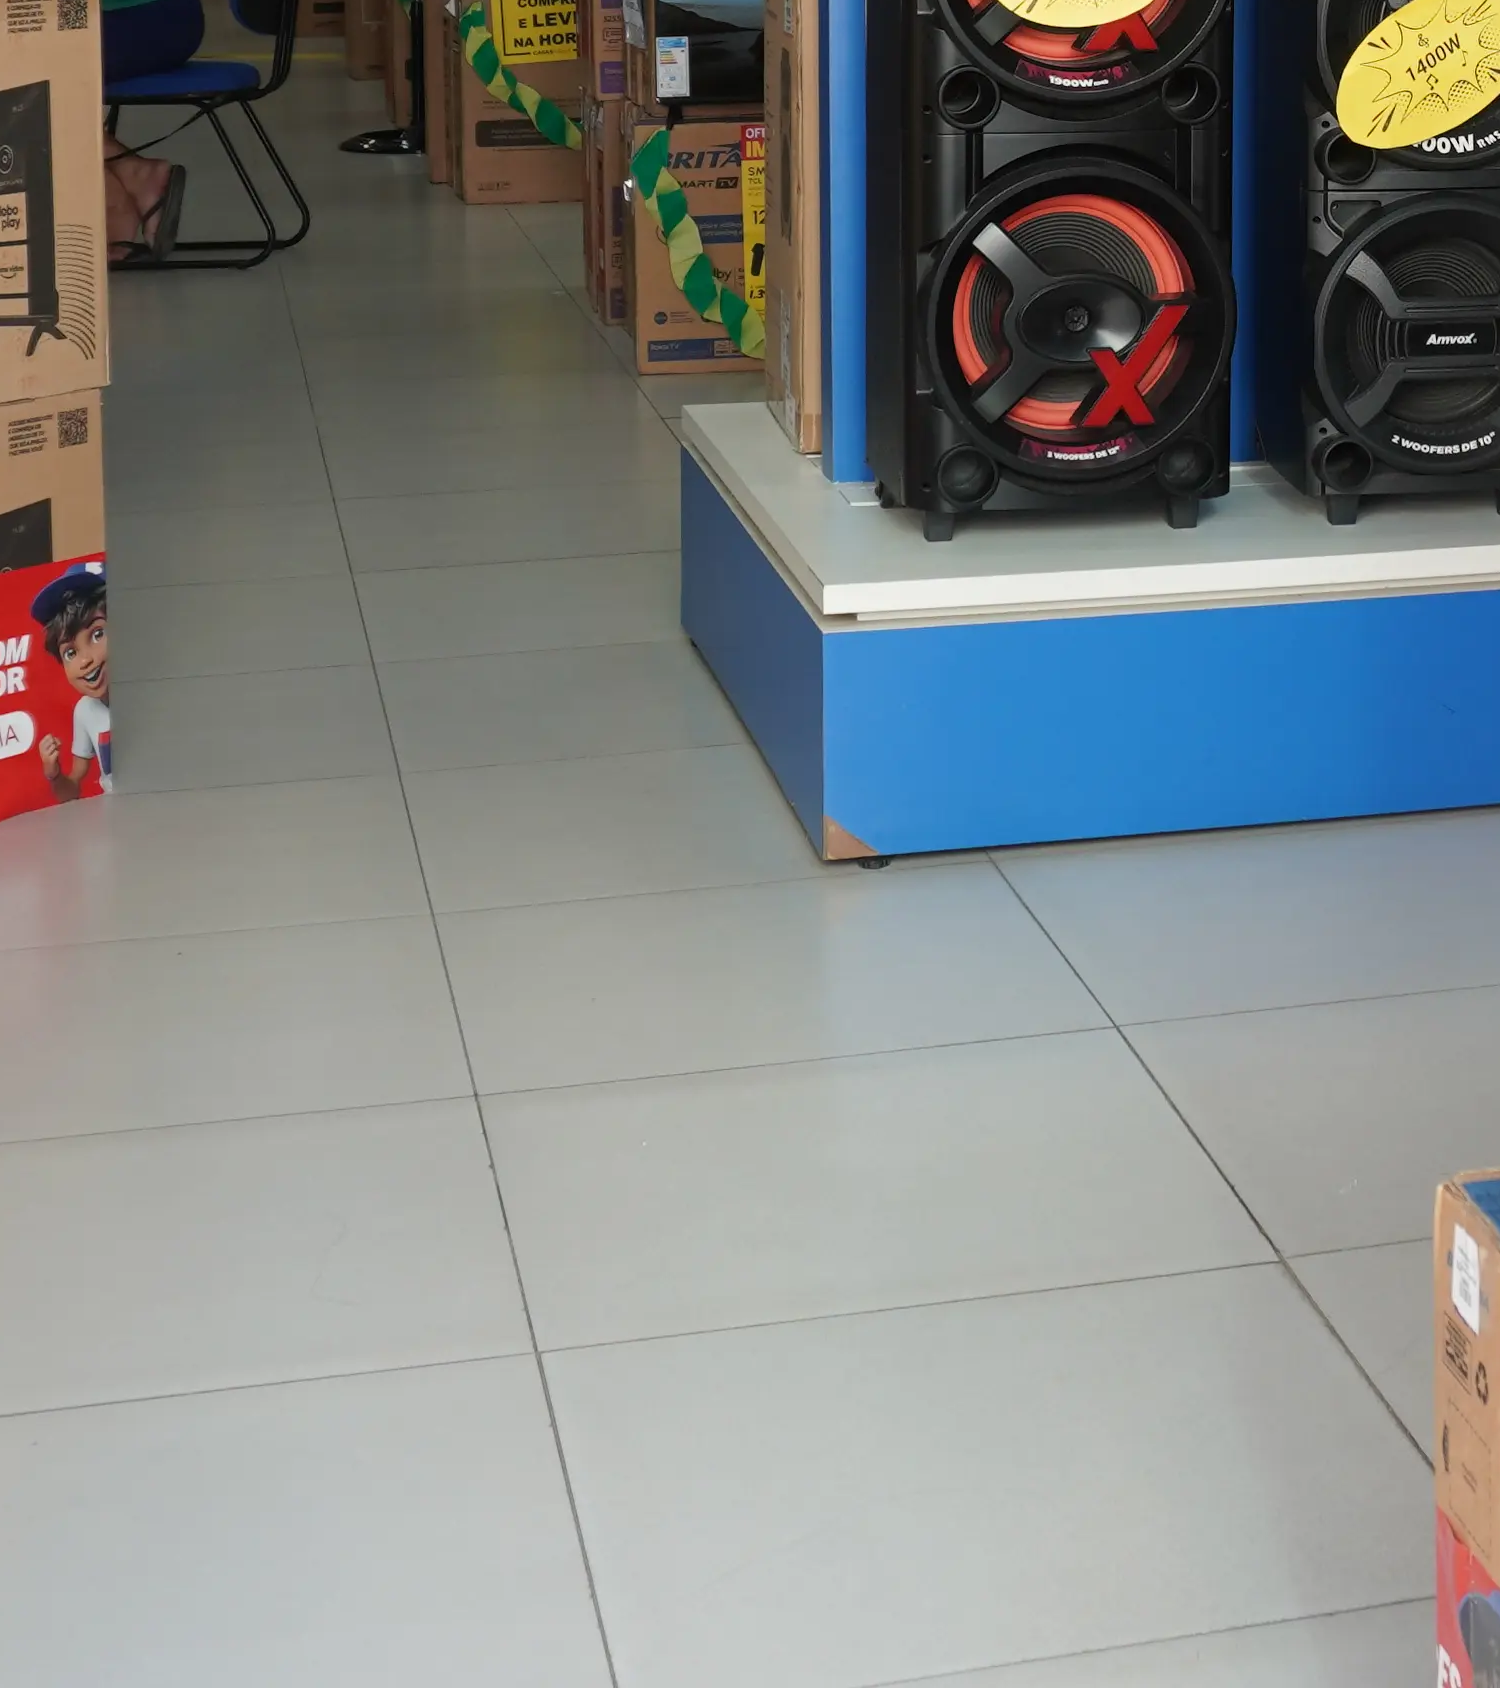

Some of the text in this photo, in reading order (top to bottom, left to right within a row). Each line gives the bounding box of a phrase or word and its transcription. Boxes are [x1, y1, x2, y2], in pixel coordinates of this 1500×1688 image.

[1405, 33, 1463, 83] 1400W
[1425, 331, 1476, 348] Amvox
[1390, 433, 1401, 446] 2
[1402, 437, 1460, 455] WOOFERS
[1460, 440, 1477, 454] DE
